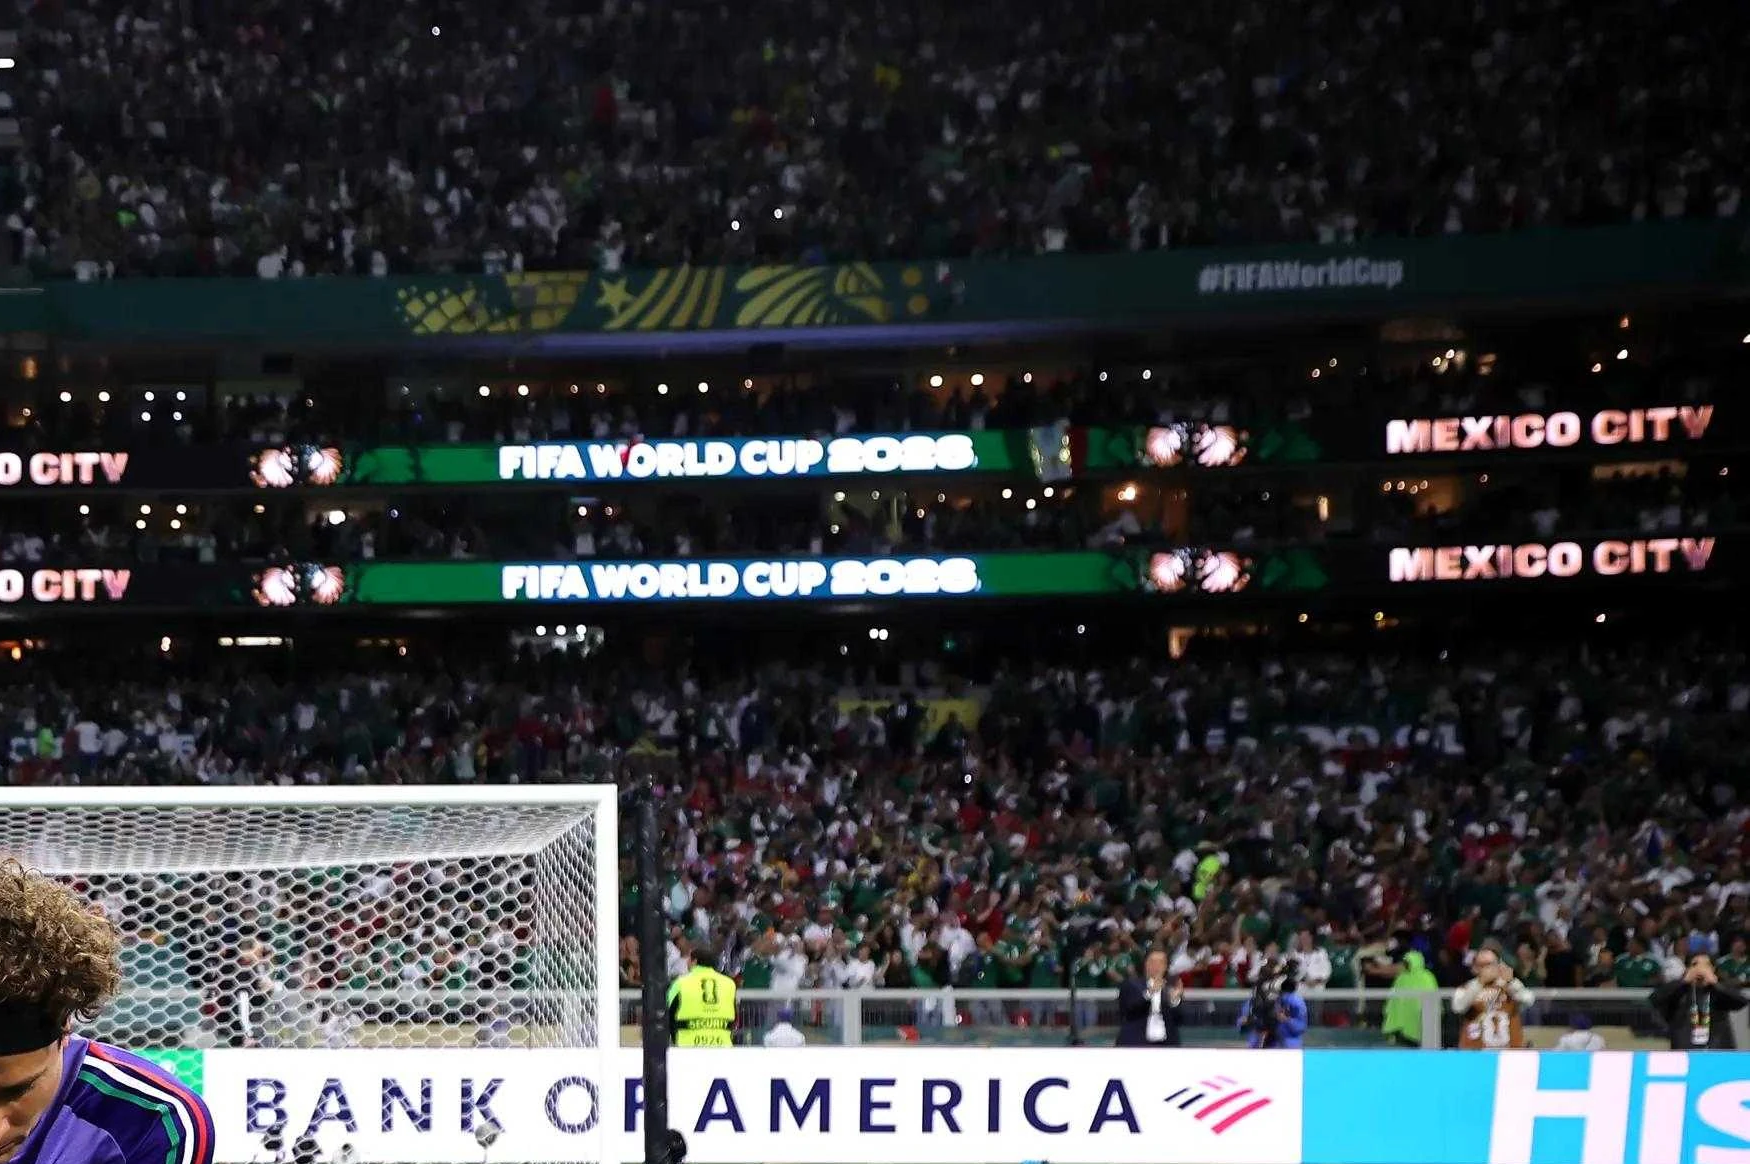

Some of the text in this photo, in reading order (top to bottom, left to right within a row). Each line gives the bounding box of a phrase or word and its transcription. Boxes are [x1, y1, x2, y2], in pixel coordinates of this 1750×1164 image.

[1198, 257, 1403, 293] #FIFAWorldCup
[1386, 405, 1714, 454] MEXICO CITY
[29, 452, 129, 485] CITY
[499, 444, 587, 479] FIFA
[588, 441, 737, 478] WORLD
[740, 439, 824, 475] CUP
[1389, 537, 1715, 582] MEXICO CITY
[31, 569, 131, 602] CITY
[502, 564, 590, 599] FIFA
[591, 562, 740, 599] WORLD
[743, 561, 827, 597] CUP
[246, 1078, 504, 1133] BANK
[693, 1077, 1141, 1134] AMERICA
